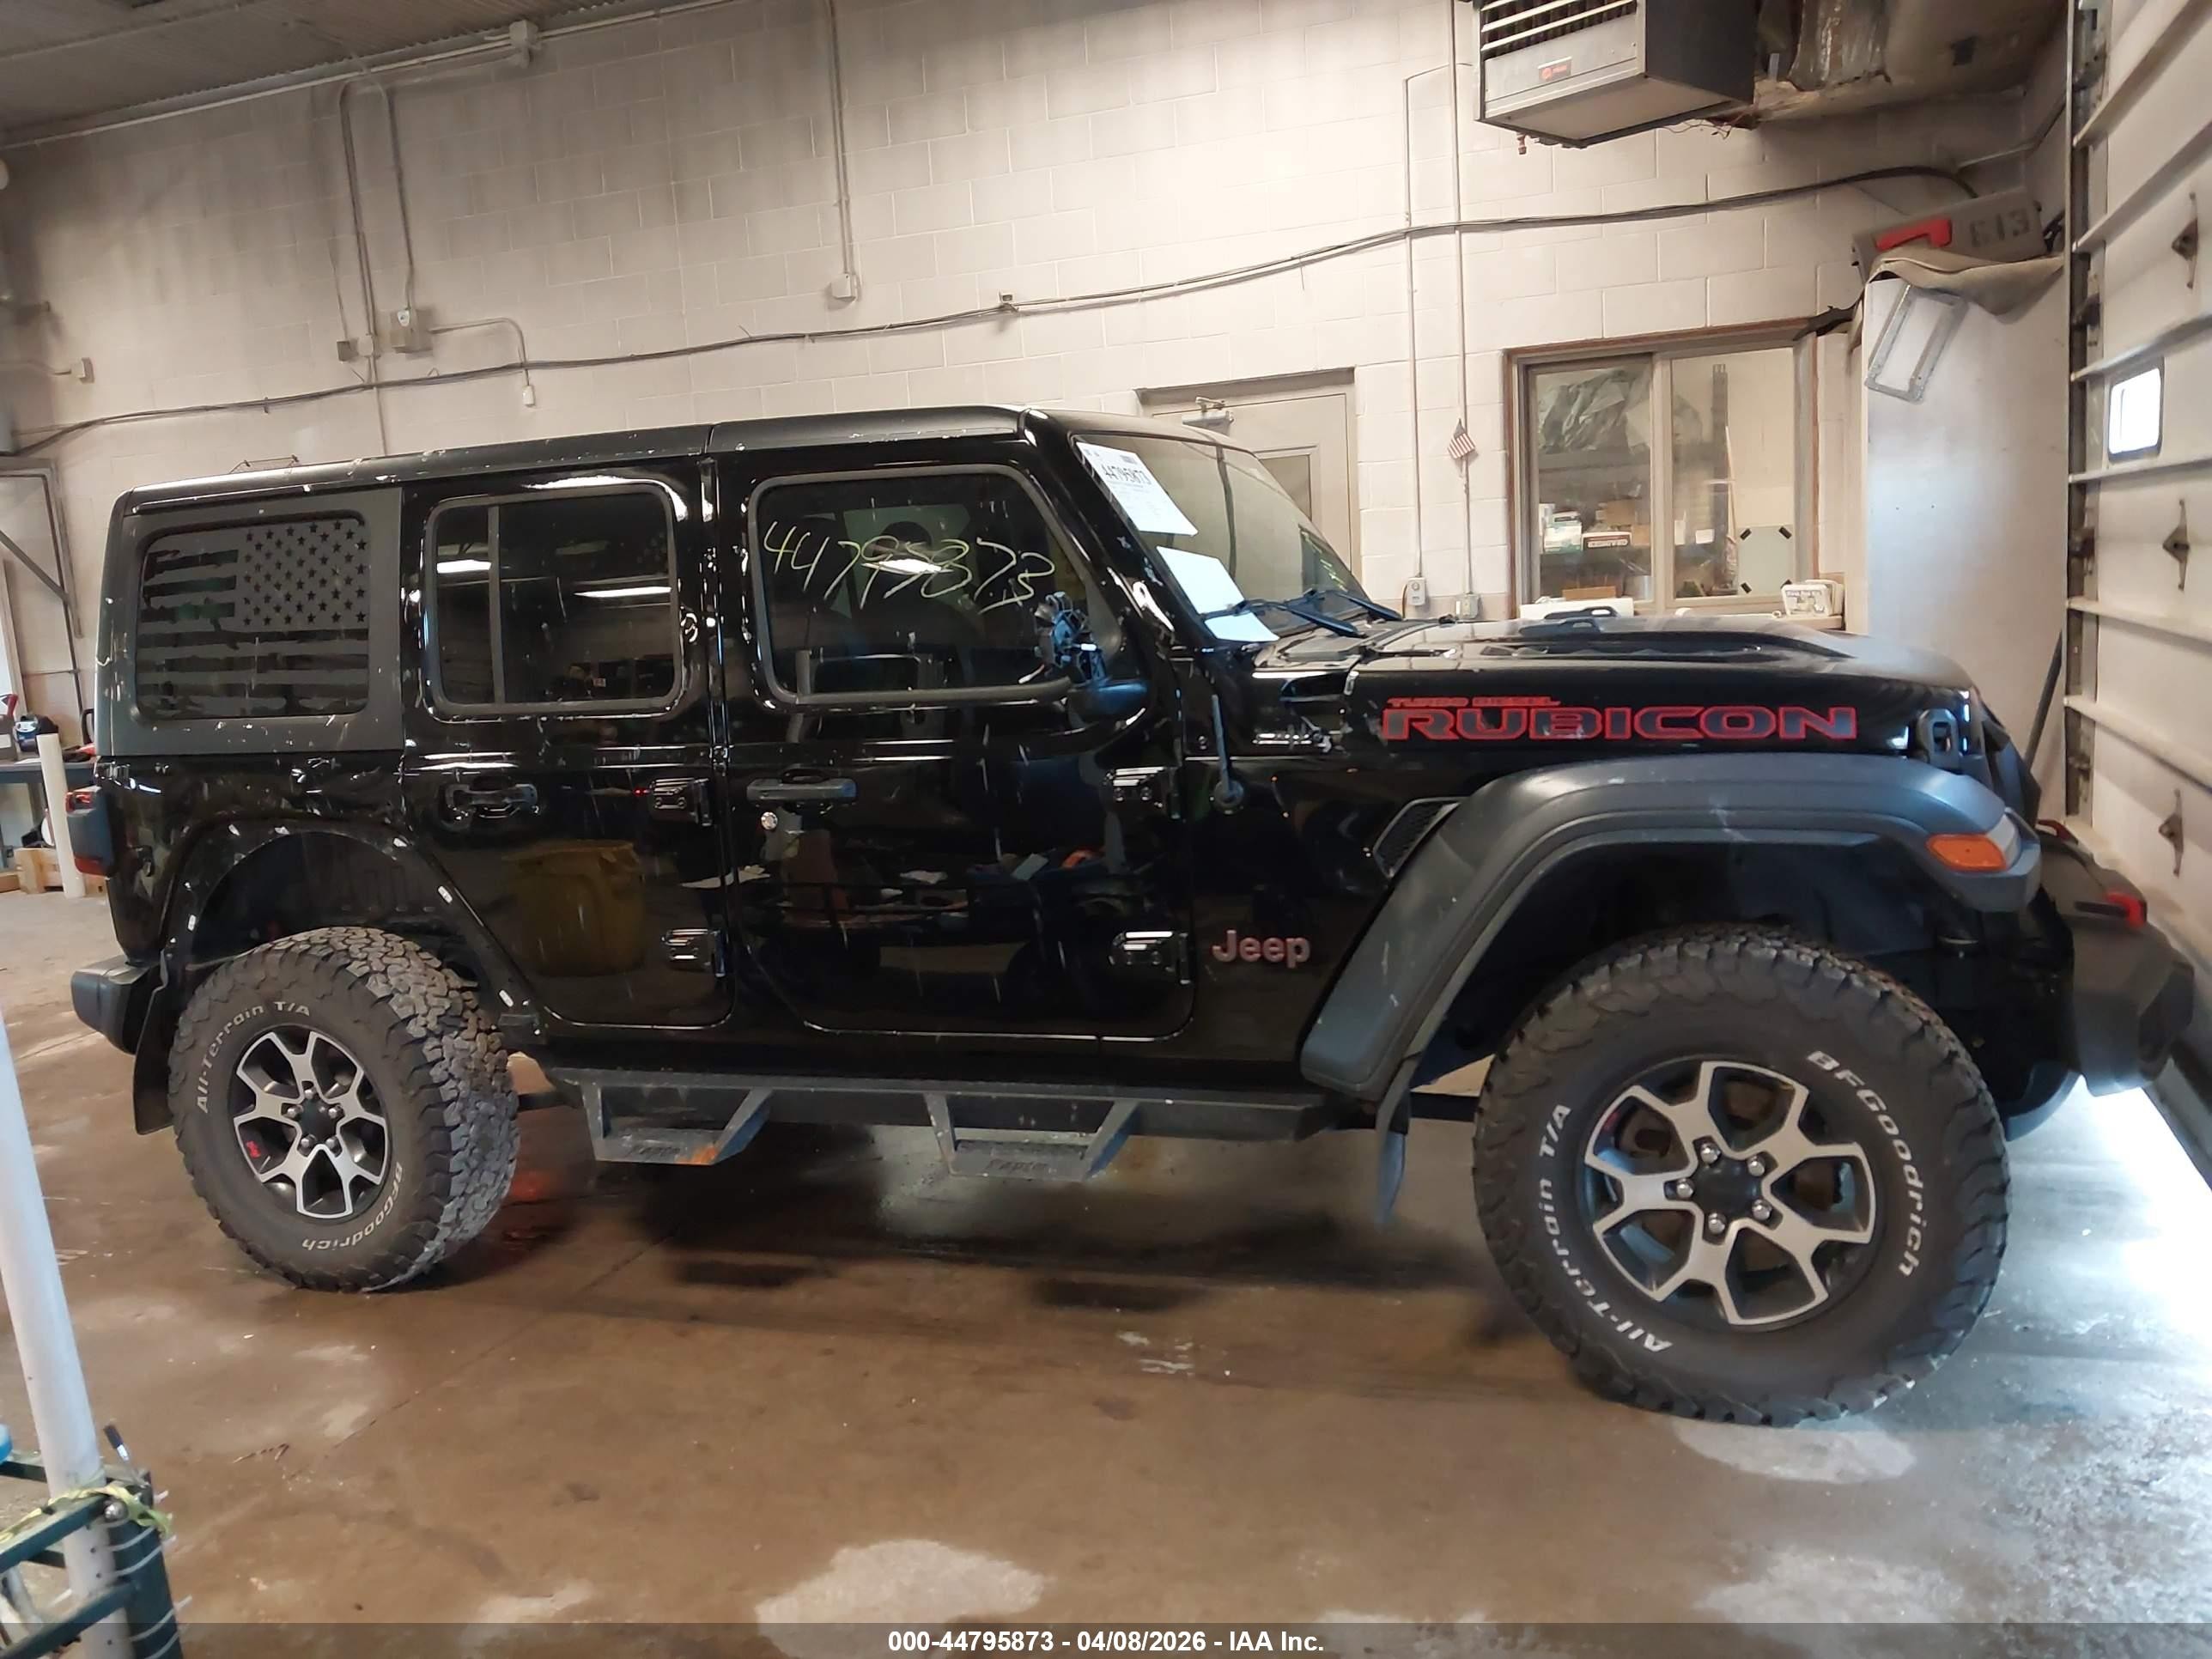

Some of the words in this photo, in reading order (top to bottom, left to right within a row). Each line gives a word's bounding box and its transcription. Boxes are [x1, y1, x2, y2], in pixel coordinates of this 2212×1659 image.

[1382, 707, 1856, 739] RUBICON
[1212, 929, 1310, 969] Jeep
[196, 1005, 264, 1113] All-Terrain
[274, 1001, 310, 1017] T/A
[1539, 1104, 1571, 1157] T/A
[1807, 1050, 1927, 1276] BFGoodrich
[302, 1162, 403, 1251] BFGoodrich
[1539, 1178, 1672, 1352] All-Terrain
